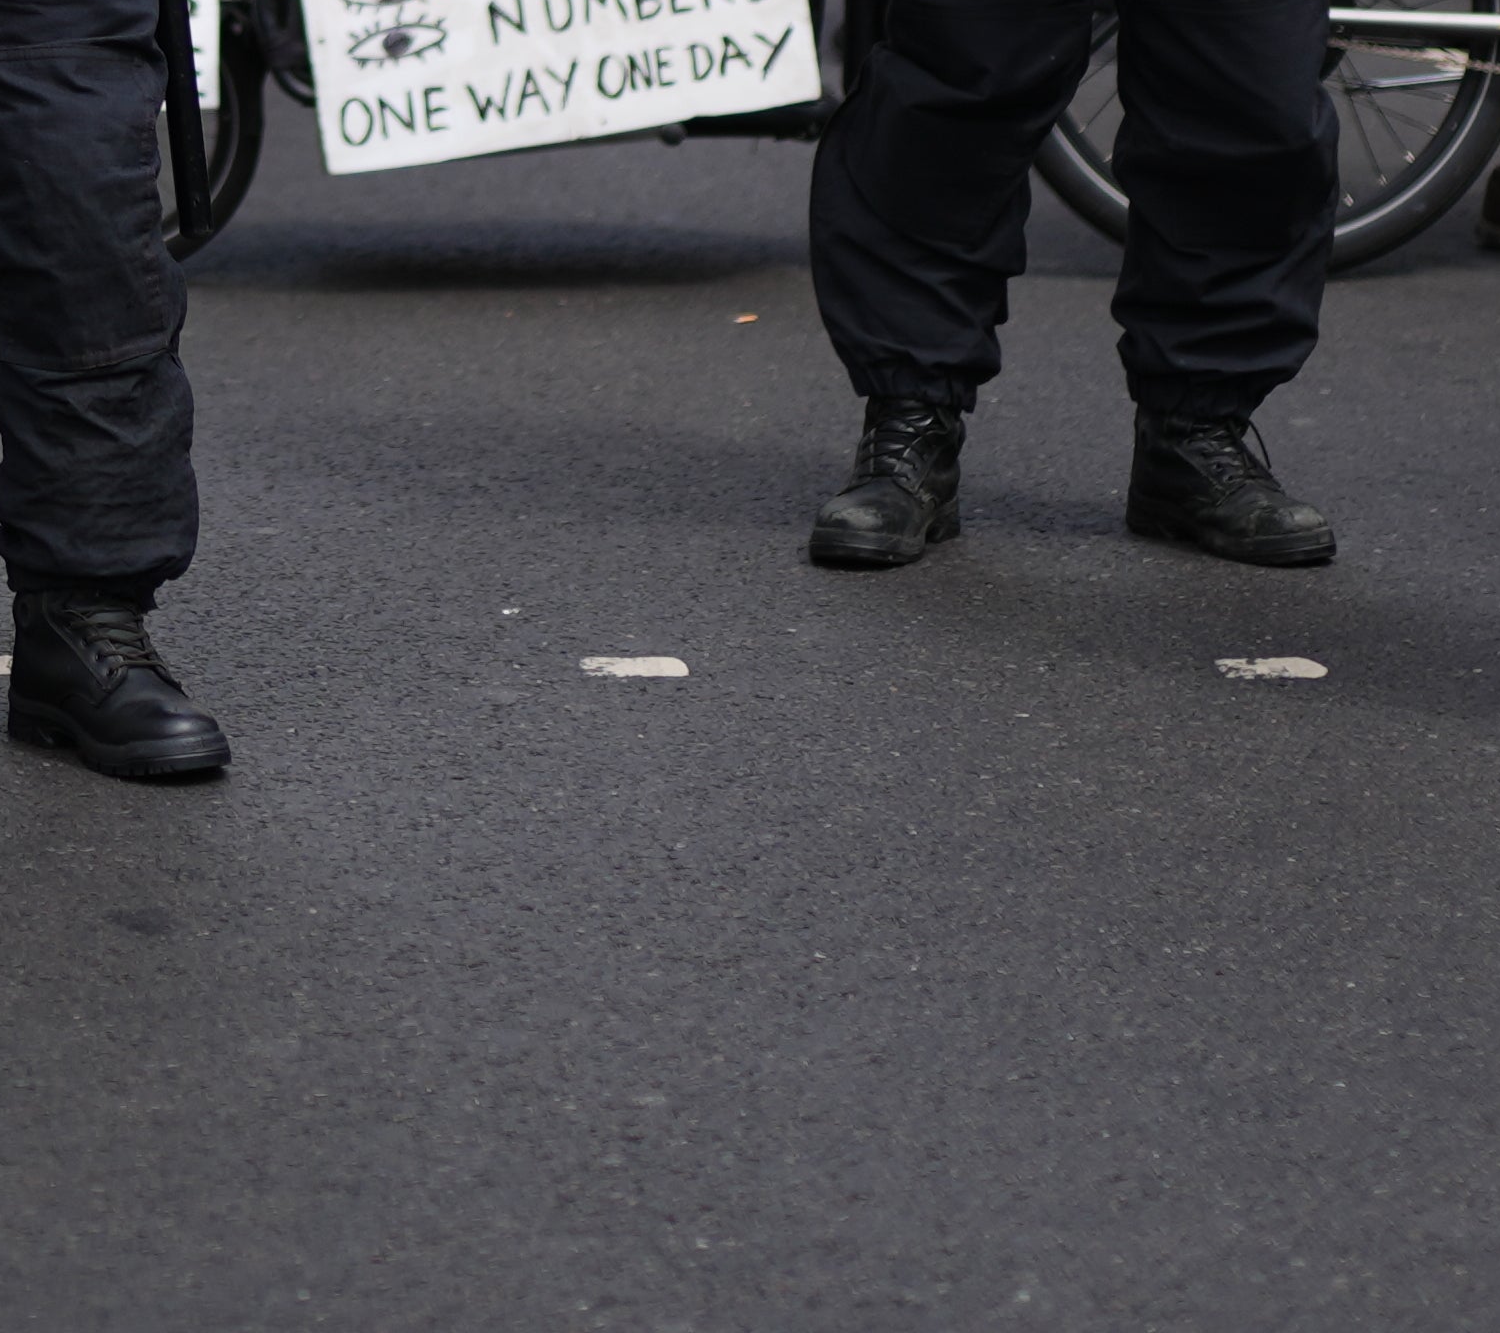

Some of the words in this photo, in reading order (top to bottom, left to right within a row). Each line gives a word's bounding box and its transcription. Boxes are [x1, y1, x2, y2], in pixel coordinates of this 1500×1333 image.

[339, 86, 450, 146] ONE
[466, 60, 579, 121] WAY
[597, 46, 675, 100] ONE
[689, 26, 794, 82] DAY
